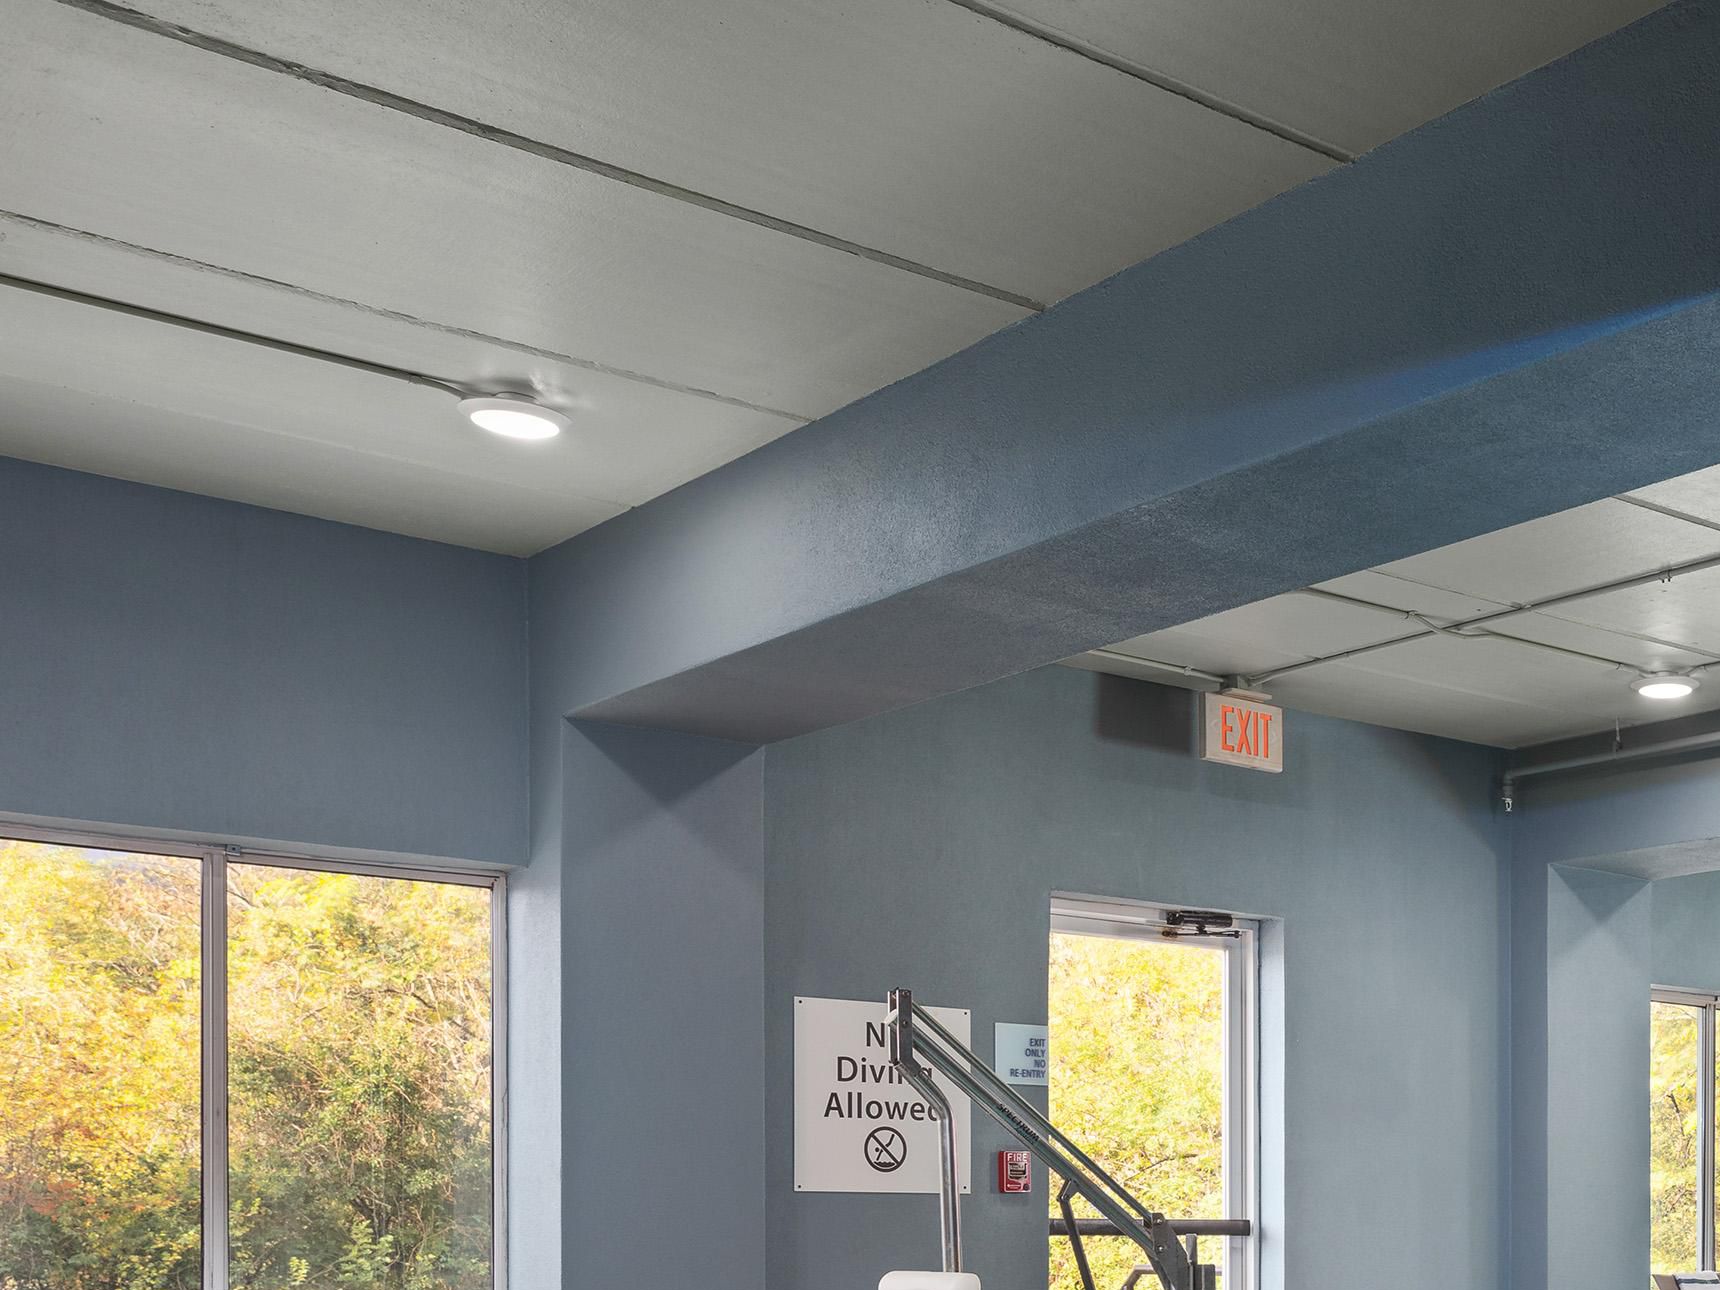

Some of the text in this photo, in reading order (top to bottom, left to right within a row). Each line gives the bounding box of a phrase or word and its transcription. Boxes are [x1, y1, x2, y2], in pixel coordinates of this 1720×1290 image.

[1221, 704, 1272, 759] EXIT
[866, 1021, 886, 1048] N
[1029, 1038, 1046, 1047] EXIT
[1024, 1048, 1046, 1058] ONLY
[1034, 1059, 1046, 1068] NO
[1009, 1068, 1046, 1079] RE-ENTRY
[1007, 1152, 1028, 1162] FIRE
